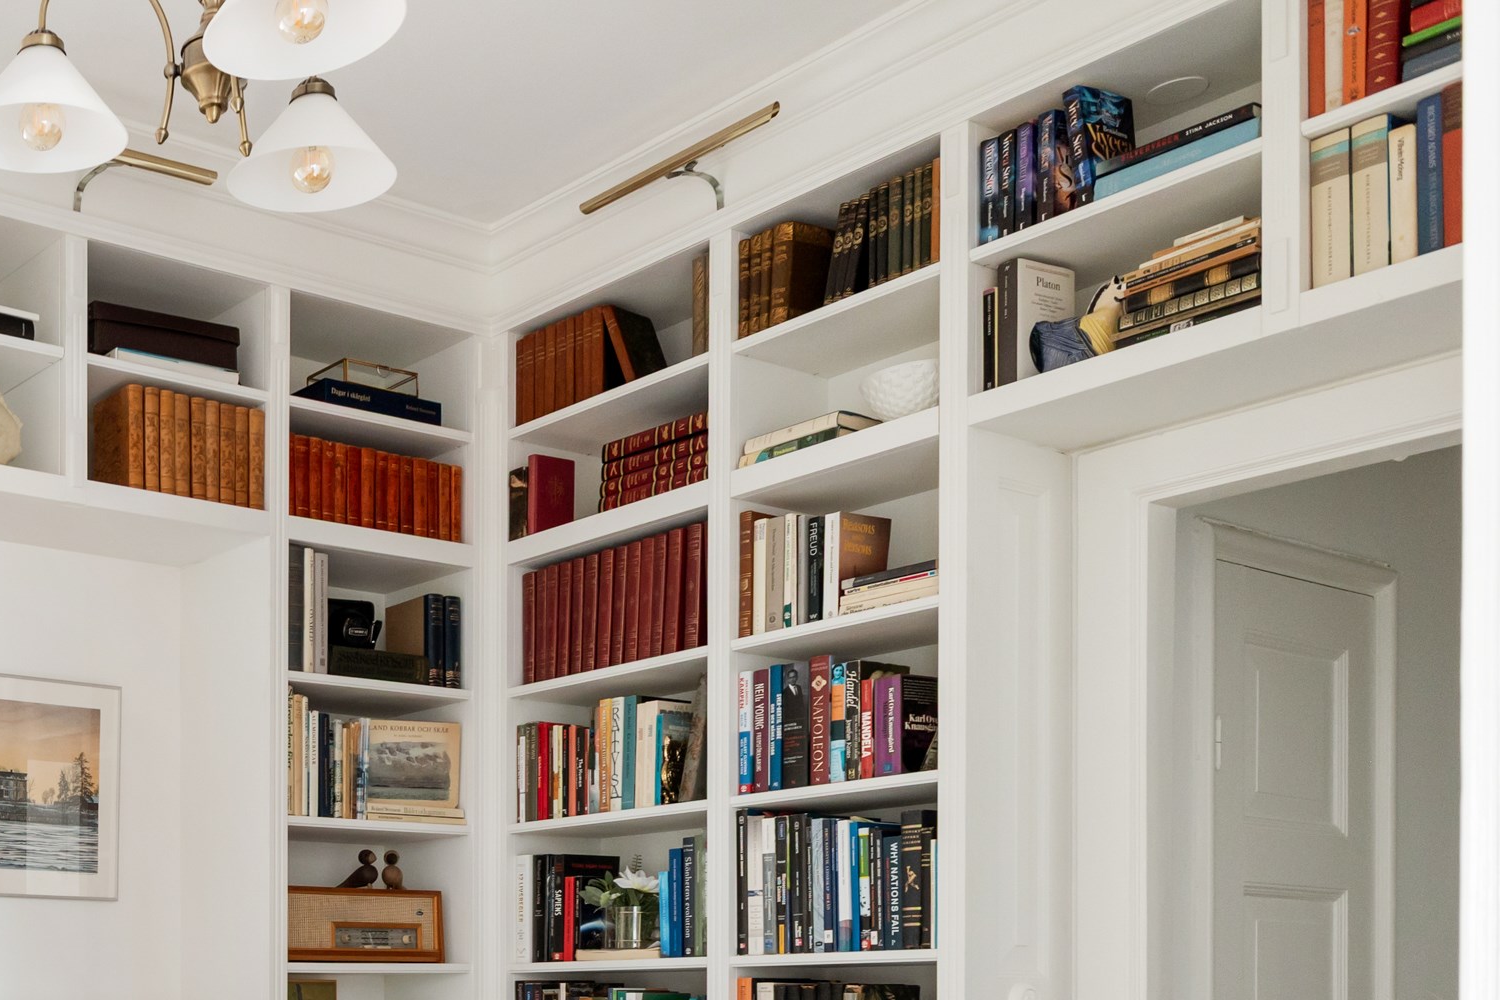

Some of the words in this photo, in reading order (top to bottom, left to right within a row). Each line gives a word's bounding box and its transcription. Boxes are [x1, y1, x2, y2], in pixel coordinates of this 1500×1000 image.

[1185, 126, 1202, 136] STINA
[1204, 114, 1233, 128] JACKSON
[1002, 134, 1013, 166] Viveca
[1072, 134, 1083, 160] Sten
[985, 174, 995, 197] Sten
[1001, 167, 1011, 189] Sten
[1036, 277, 1060, 291] Platon
[331, 387, 346, 397] Dagar
[842, 518, 875, 535] Reasons
[844, 541, 872, 555] Persons
[755, 683, 764, 702] NEIL
[846, 670, 858, 708] Handel
[755, 703, 764, 730] YOUNG
[909, 714, 925, 722] Karl
[813, 695, 823, 772] NAPOLEON
[861, 711, 872, 758] MANDELA
[890, 843, 898, 864] WHY
[684, 856, 692, 900] Skönhetens
[891, 867, 899, 912] NATIONS
[554, 890, 562, 916] SAPIENS
[891, 915, 899, 935] FAIL
